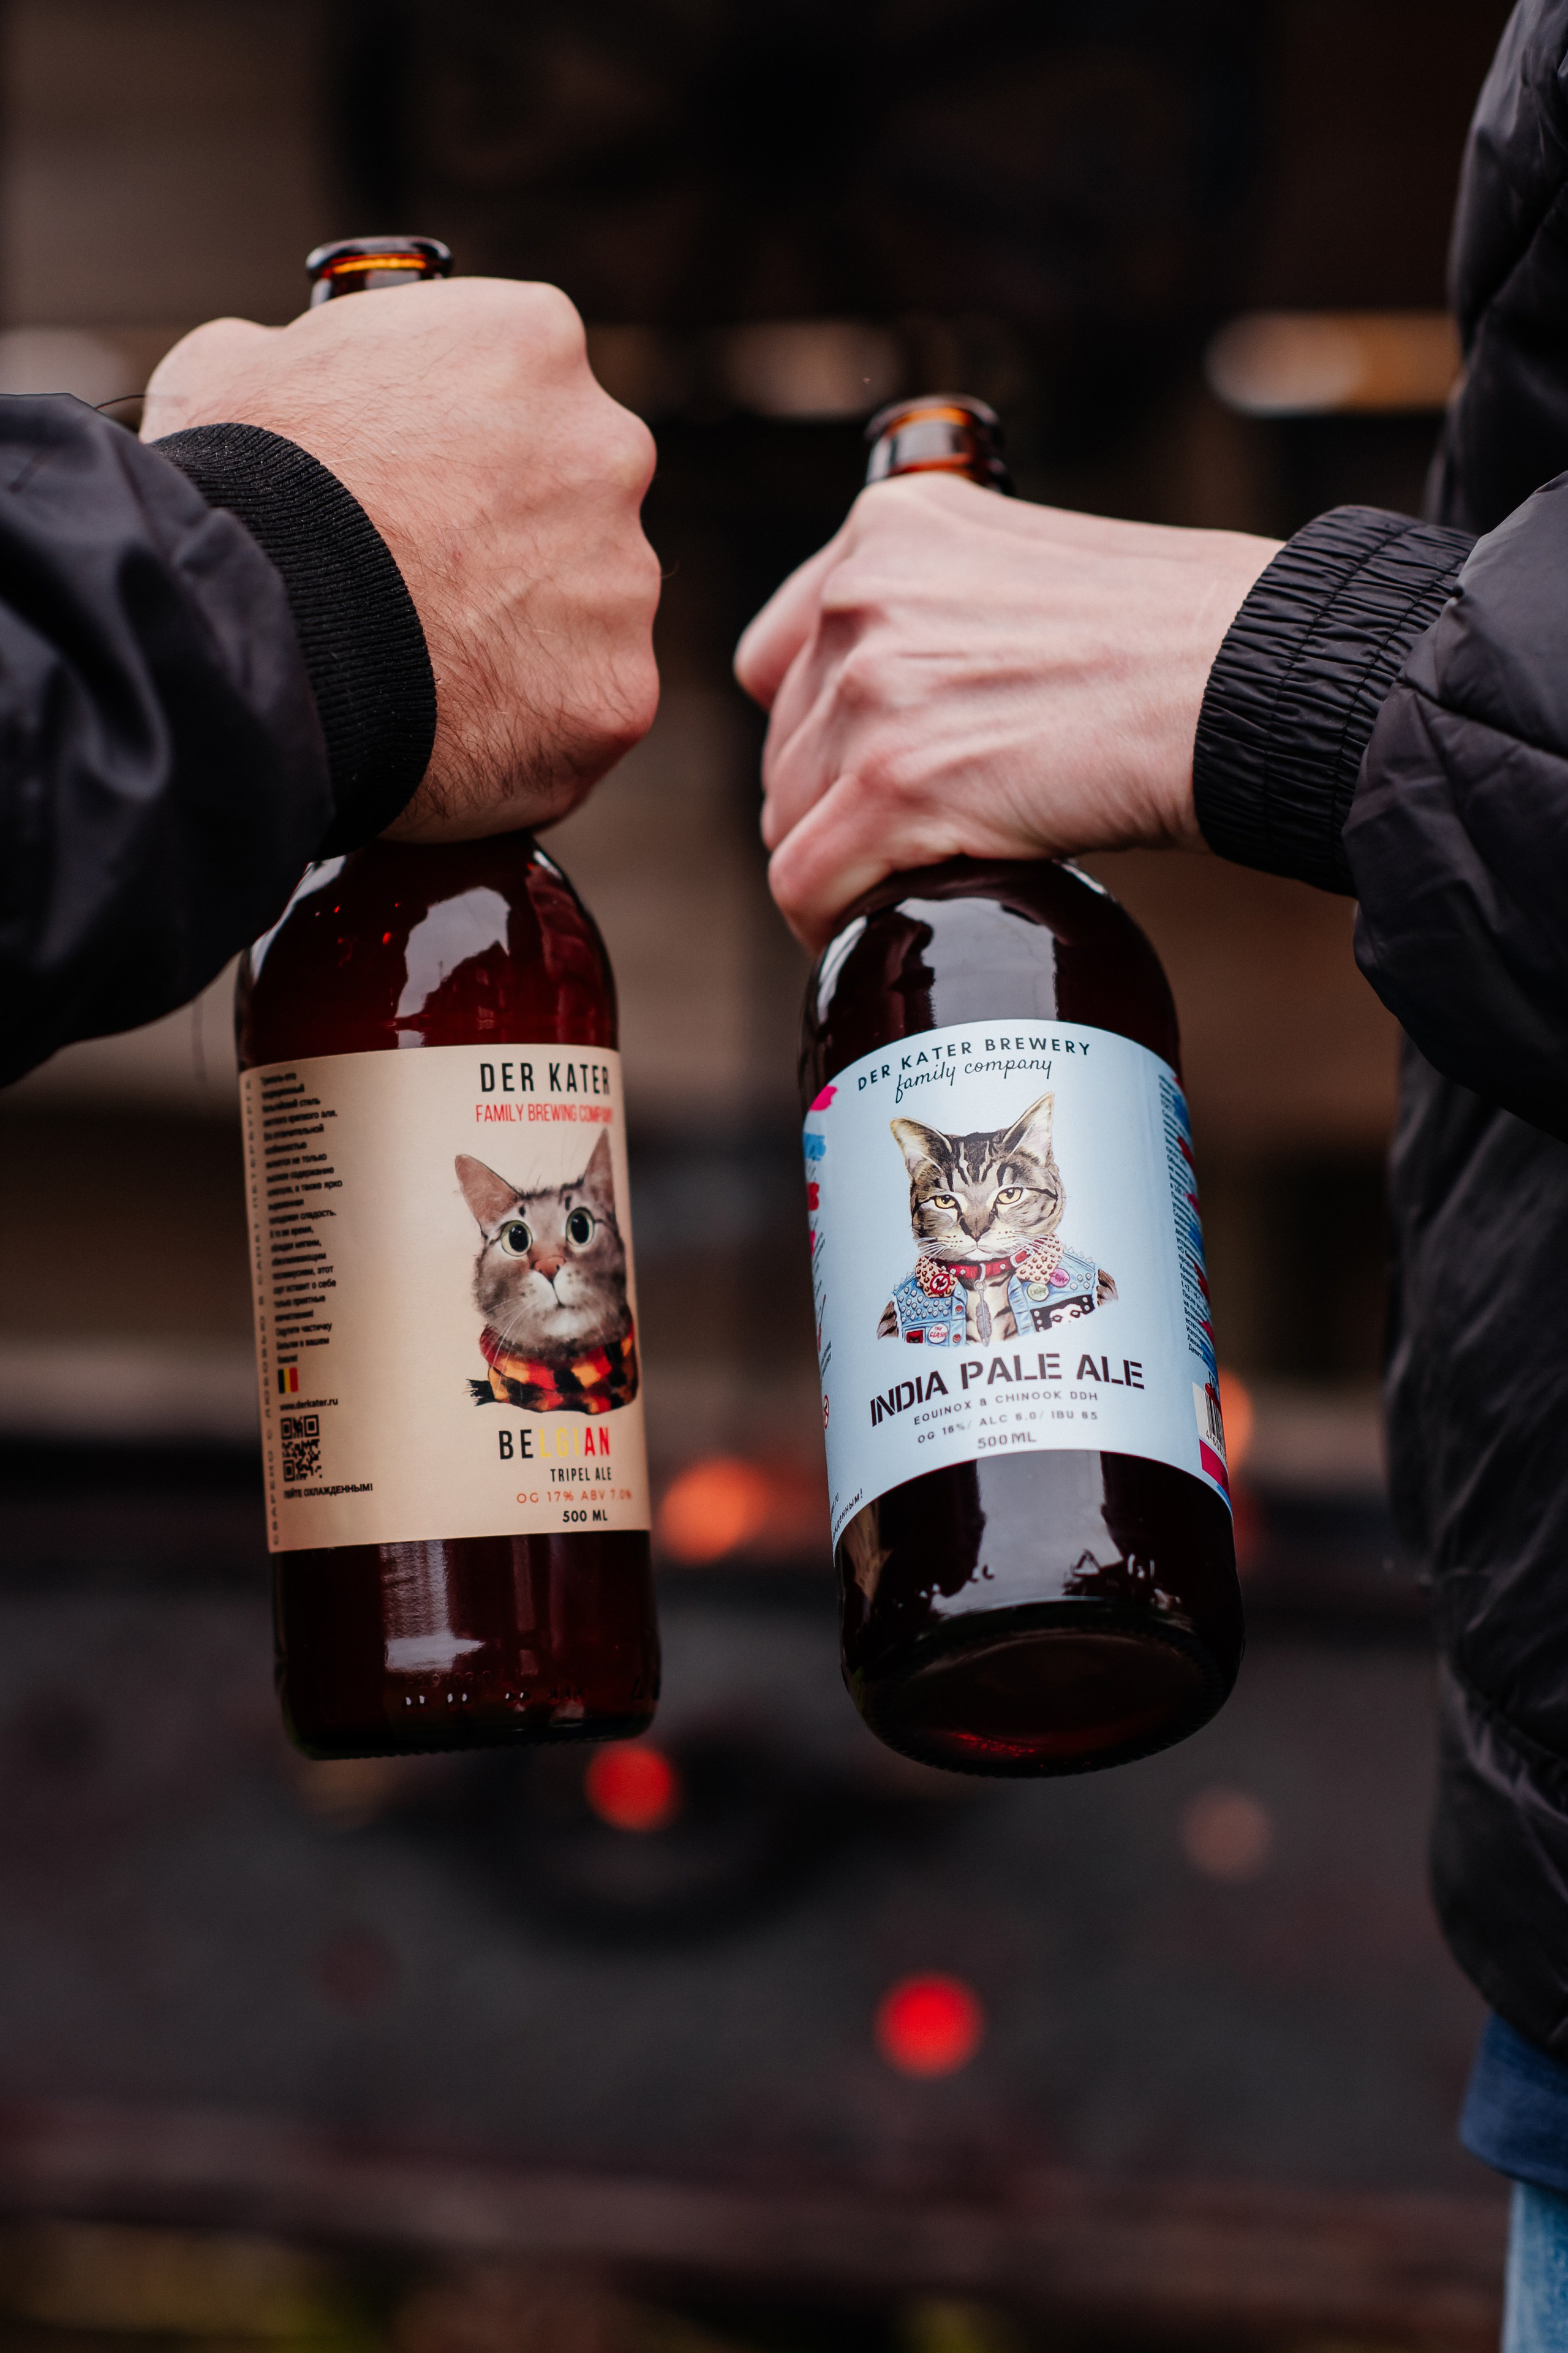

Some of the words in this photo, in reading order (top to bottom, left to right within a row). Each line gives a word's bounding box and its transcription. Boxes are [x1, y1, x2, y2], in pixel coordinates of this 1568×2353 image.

[480, 1063, 534, 1092] DER
[549, 1063, 610, 1095] KATER
[858, 1064, 891, 1090] DER
[901, 1041, 973, 1070] KATER
[985, 1037, 1091, 1056] BREWERY
[895, 1061, 956, 1104] family
[964, 1059, 1052, 1079] company
[476, 1104, 524, 1122] FAMILY
[528, 1103, 577, 1122] BREWING
[318, 1278, 336, 1288] себе
[870, 1370, 949, 1427] INDIA
[960, 1353, 1062, 1389] PALE
[1076, 1354, 1145, 1390] ALE
[914, 1400, 972, 1426] EQUINOX
[995, 1391, 1061, 1405] CHINOOK
[1070, 1391, 1098, 1401] DDH
[499, 1426, 610, 1459] BELGIAN
[918, 1431, 935, 1443] OG
[979, 1414, 1007, 1426] ALC
[1051, 1410, 1074, 1419] IBU
[303, 1482, 373, 1497] ОХЛАЖДЕННЫМ!
[550, 1468, 590, 1482] TRIPEL
[595, 1467, 612, 1481] ALE
[516, 1492, 539, 1503] OG
[548, 1490, 574, 1502] 17%
[581, 1489, 605, 1501] ABV
[562, 1509, 587, 1522] 500
[593, 1509, 608, 1521] ML
